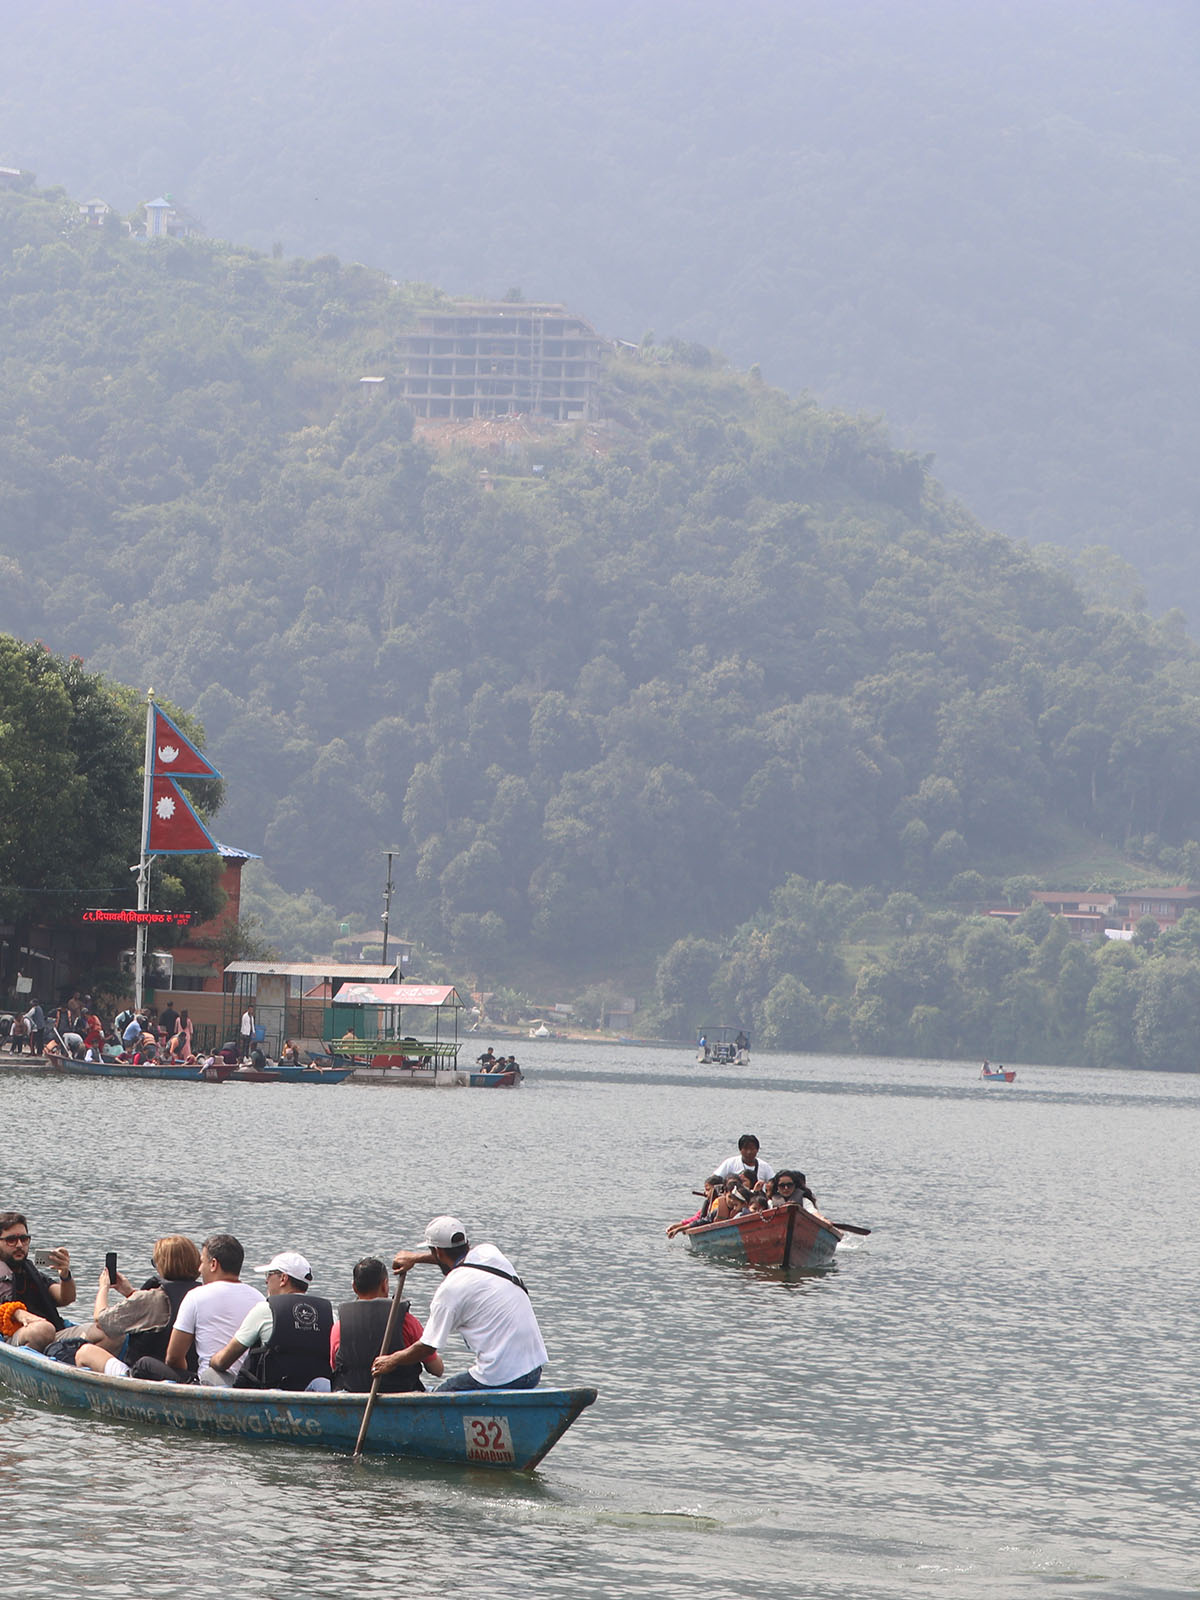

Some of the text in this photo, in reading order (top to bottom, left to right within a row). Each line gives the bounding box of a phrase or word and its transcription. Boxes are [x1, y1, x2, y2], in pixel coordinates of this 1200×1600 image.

[84, 1391, 158, 1424] Welcome
[162, 1405, 186, 1428] to
[471, 1420, 506, 1450] 32
